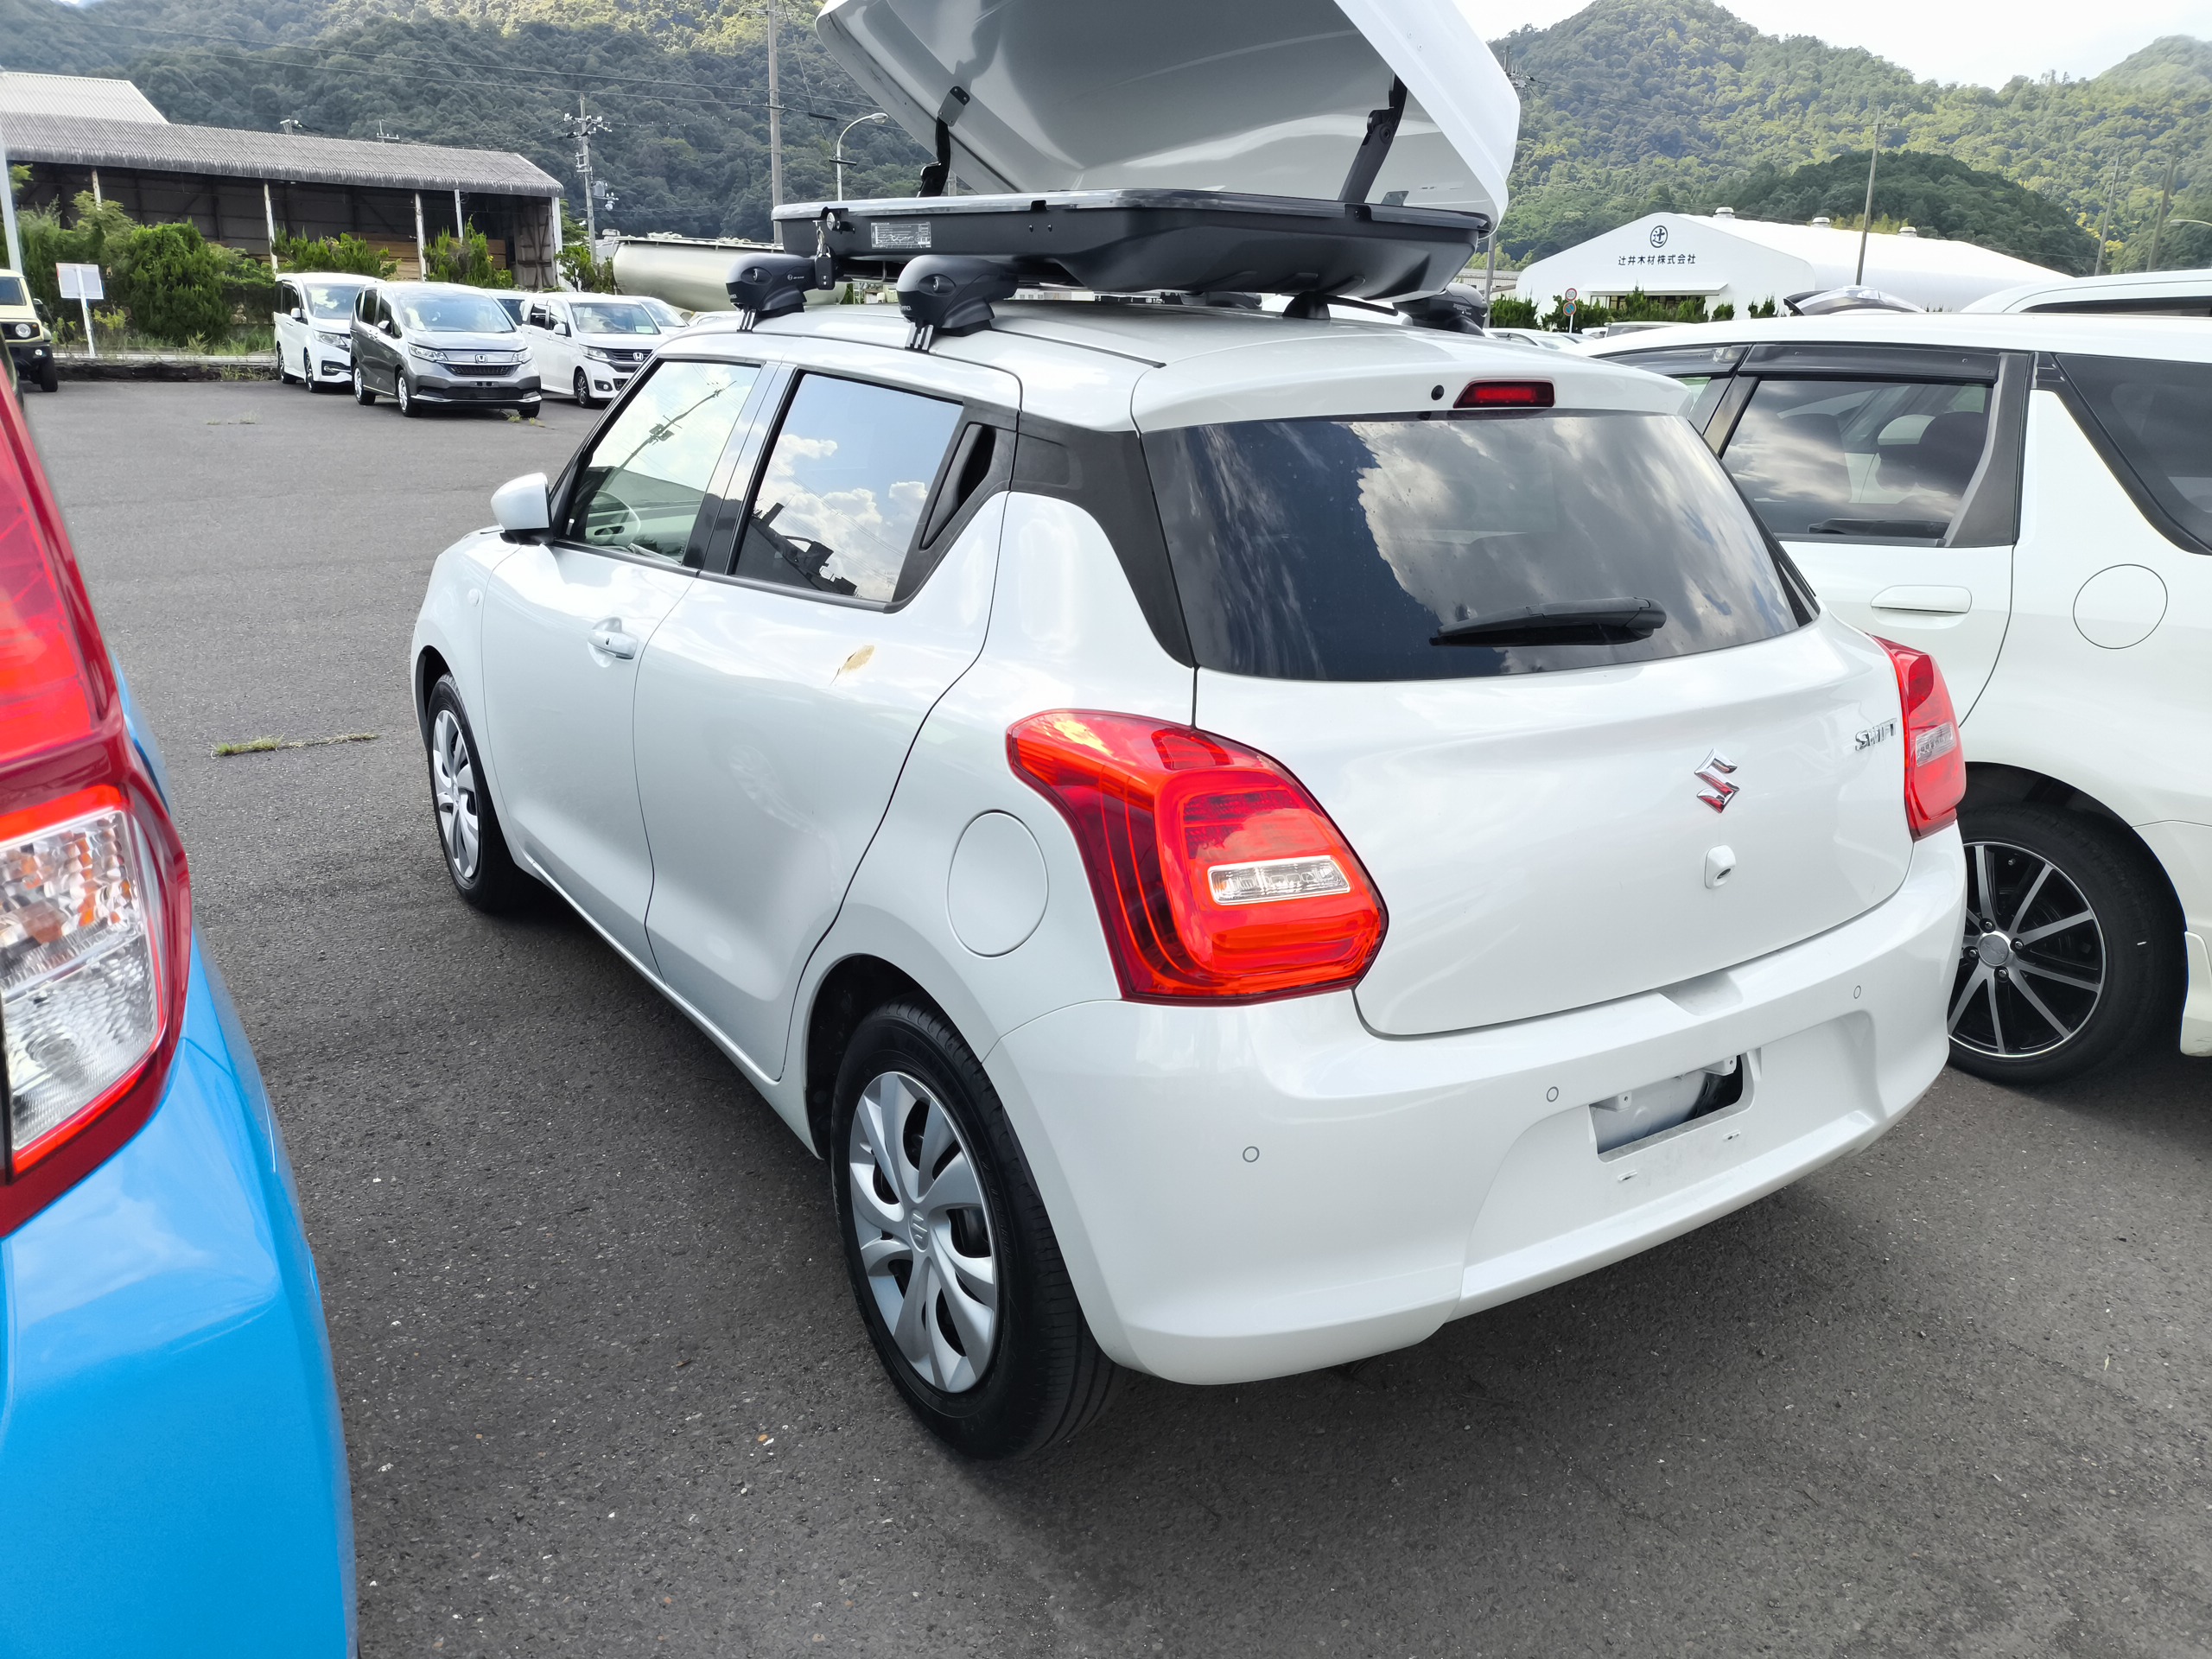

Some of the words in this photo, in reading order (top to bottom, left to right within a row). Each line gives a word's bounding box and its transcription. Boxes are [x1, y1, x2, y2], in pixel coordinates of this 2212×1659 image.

[1618, 253, 1695, 266] 辻井木材株式会社
[1855, 717, 1897, 751] SWIFT
